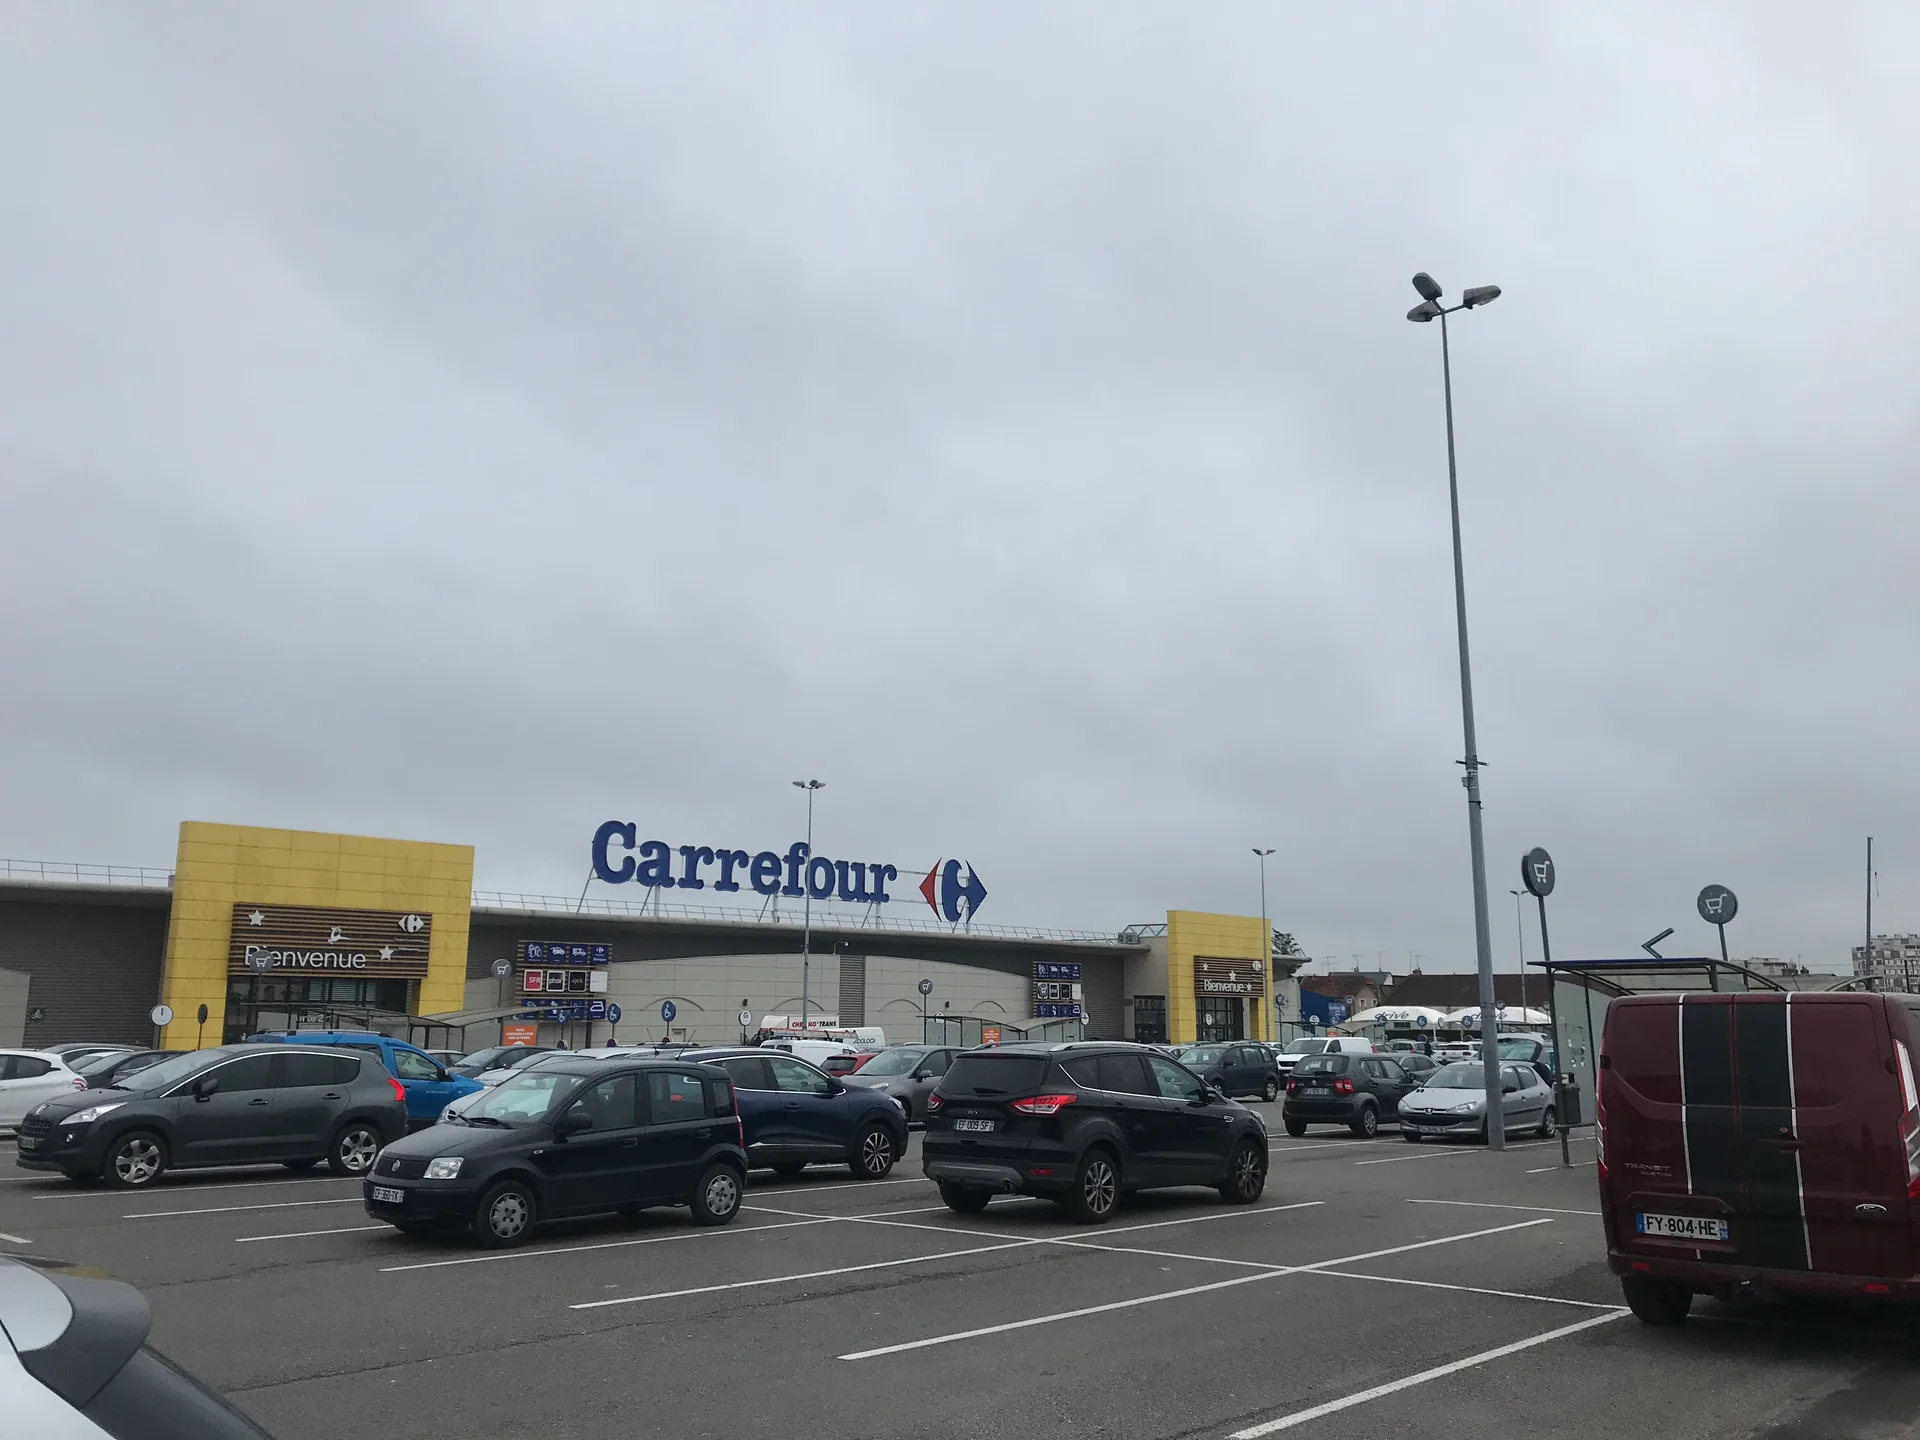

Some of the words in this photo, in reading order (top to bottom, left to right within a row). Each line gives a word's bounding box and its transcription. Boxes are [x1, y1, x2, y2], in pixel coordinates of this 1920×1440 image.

[592, 820, 897, 903] Carrefour
[245, 945, 366, 969] Benvenue
[1204, 979, 1245, 993] Bienvenue
[1624, 1162, 1671, 1171] TRANSIT
